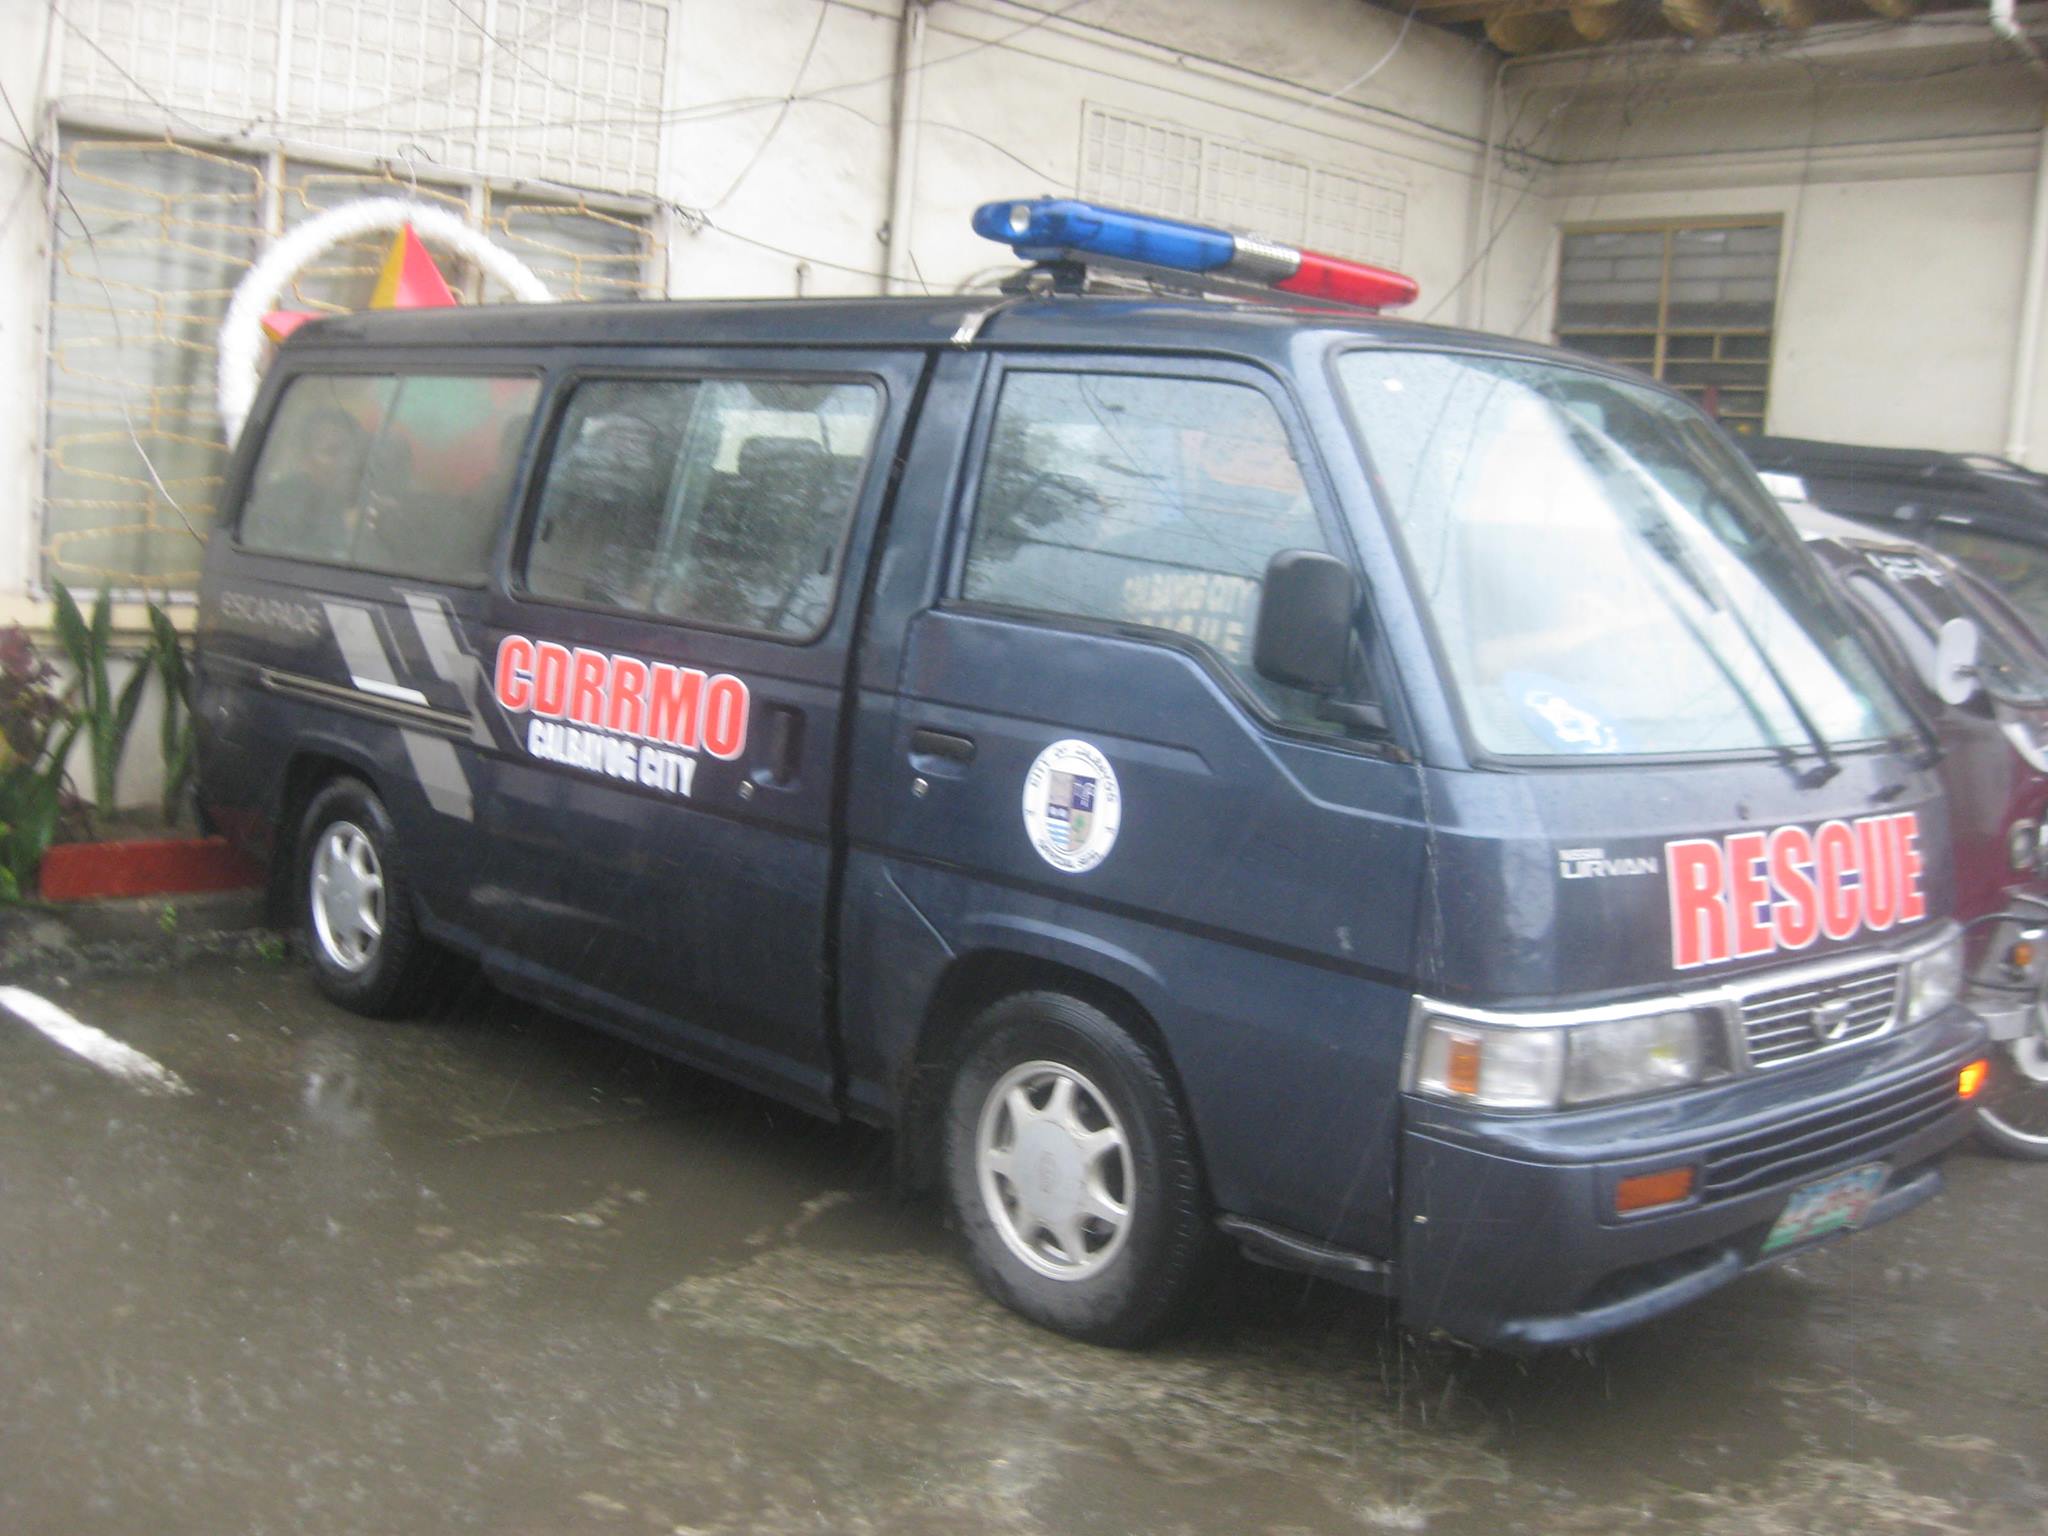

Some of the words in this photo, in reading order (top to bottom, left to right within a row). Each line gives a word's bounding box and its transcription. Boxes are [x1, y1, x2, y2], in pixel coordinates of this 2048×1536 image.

[495, 634, 750, 760] CDRRMO
[639, 745, 697, 798] CITY
[1559, 857, 1659, 879] URVAN
[1665, 812, 1928, 970] RESCUE
